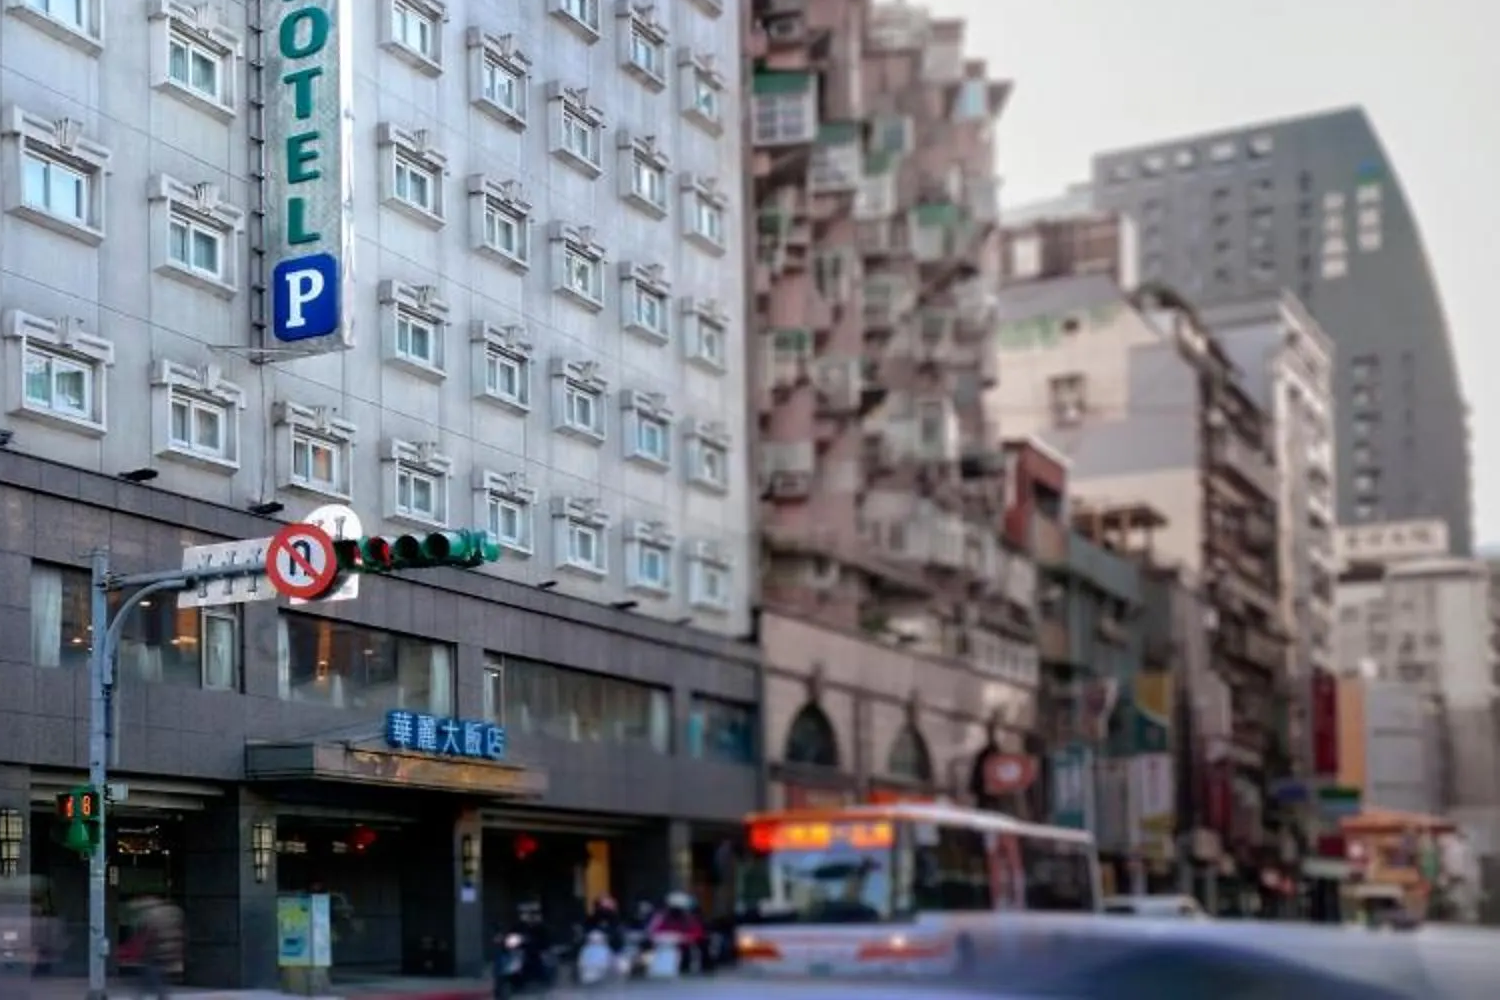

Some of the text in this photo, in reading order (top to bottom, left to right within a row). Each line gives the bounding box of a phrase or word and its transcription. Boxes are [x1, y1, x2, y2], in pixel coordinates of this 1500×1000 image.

[285, 268, 325, 329] P
[391, 711, 505, 758] 華麗大飯店
